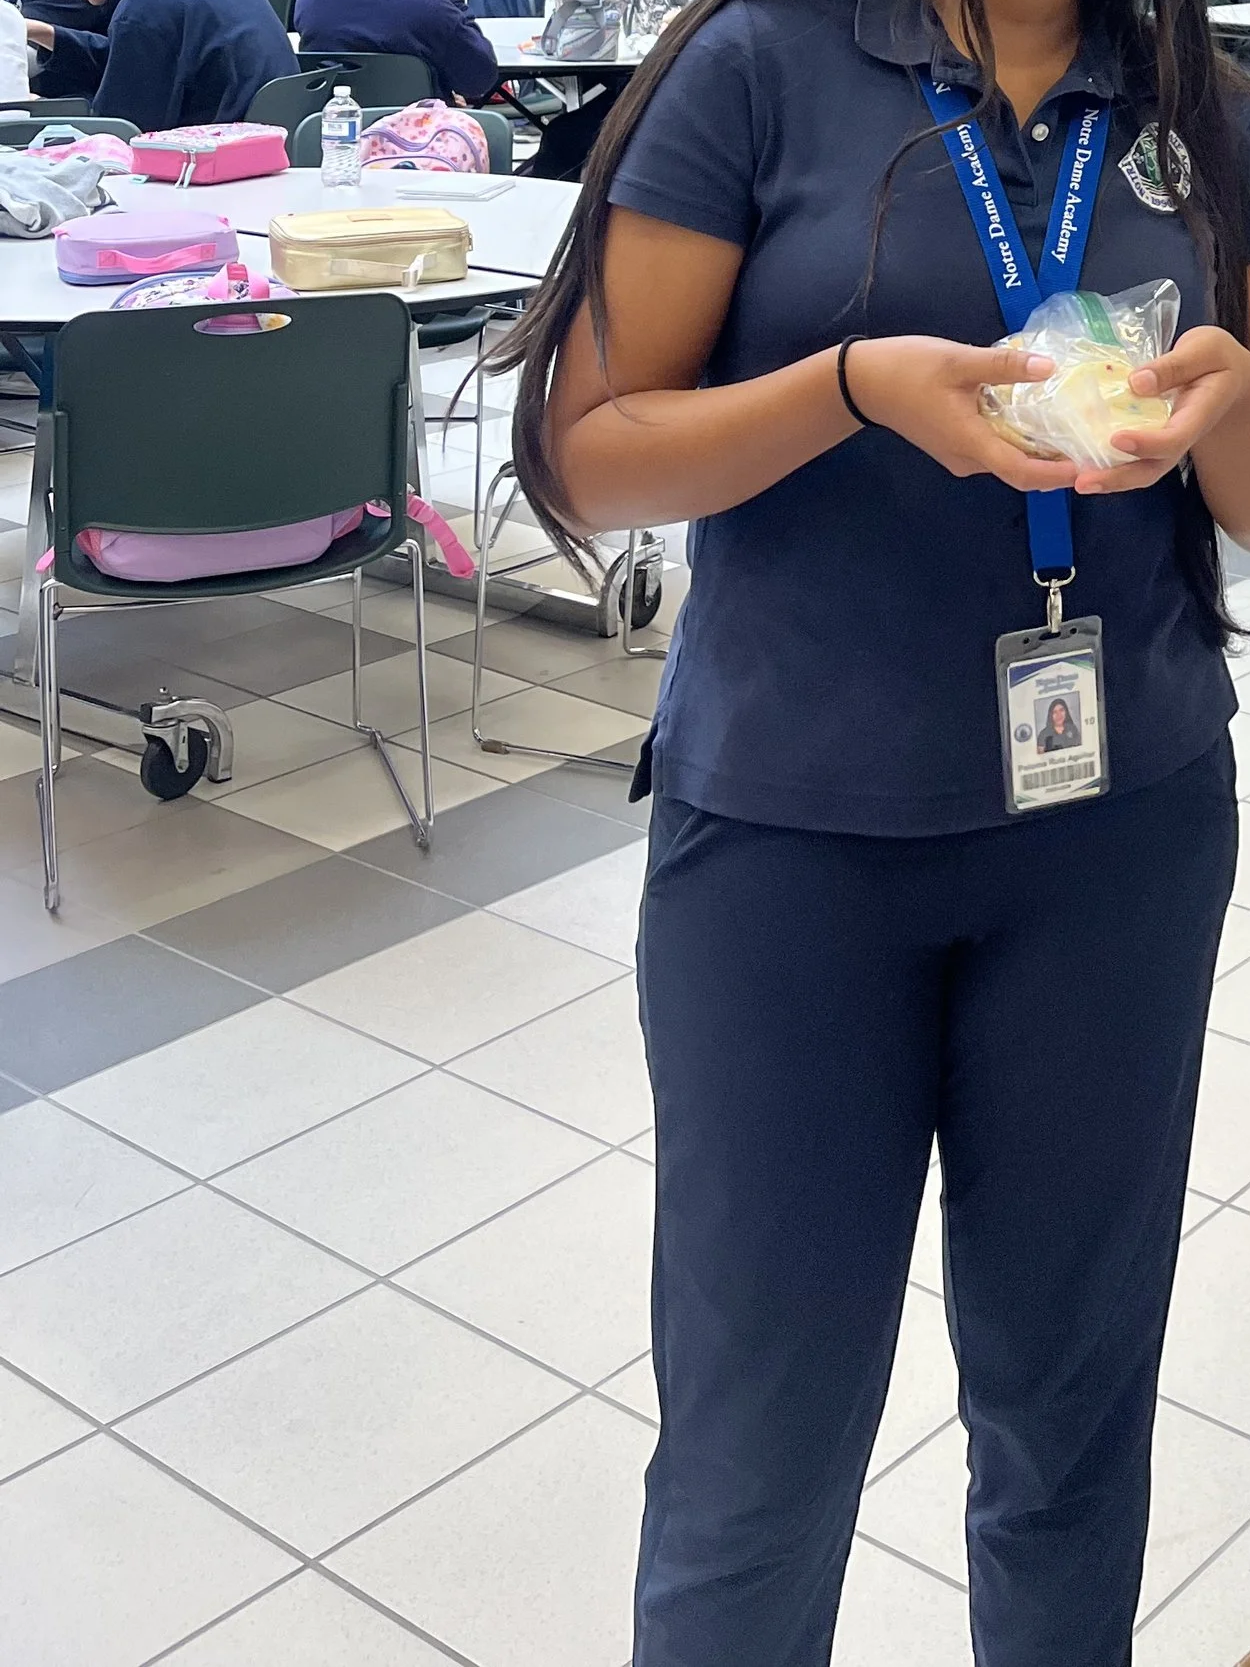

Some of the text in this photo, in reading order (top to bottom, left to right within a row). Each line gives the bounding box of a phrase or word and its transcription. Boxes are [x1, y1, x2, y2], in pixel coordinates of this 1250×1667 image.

[956, 123, 1022, 289] Notre Dame Academy
[1051, 108, 1100, 264] Notre Dame Academy
